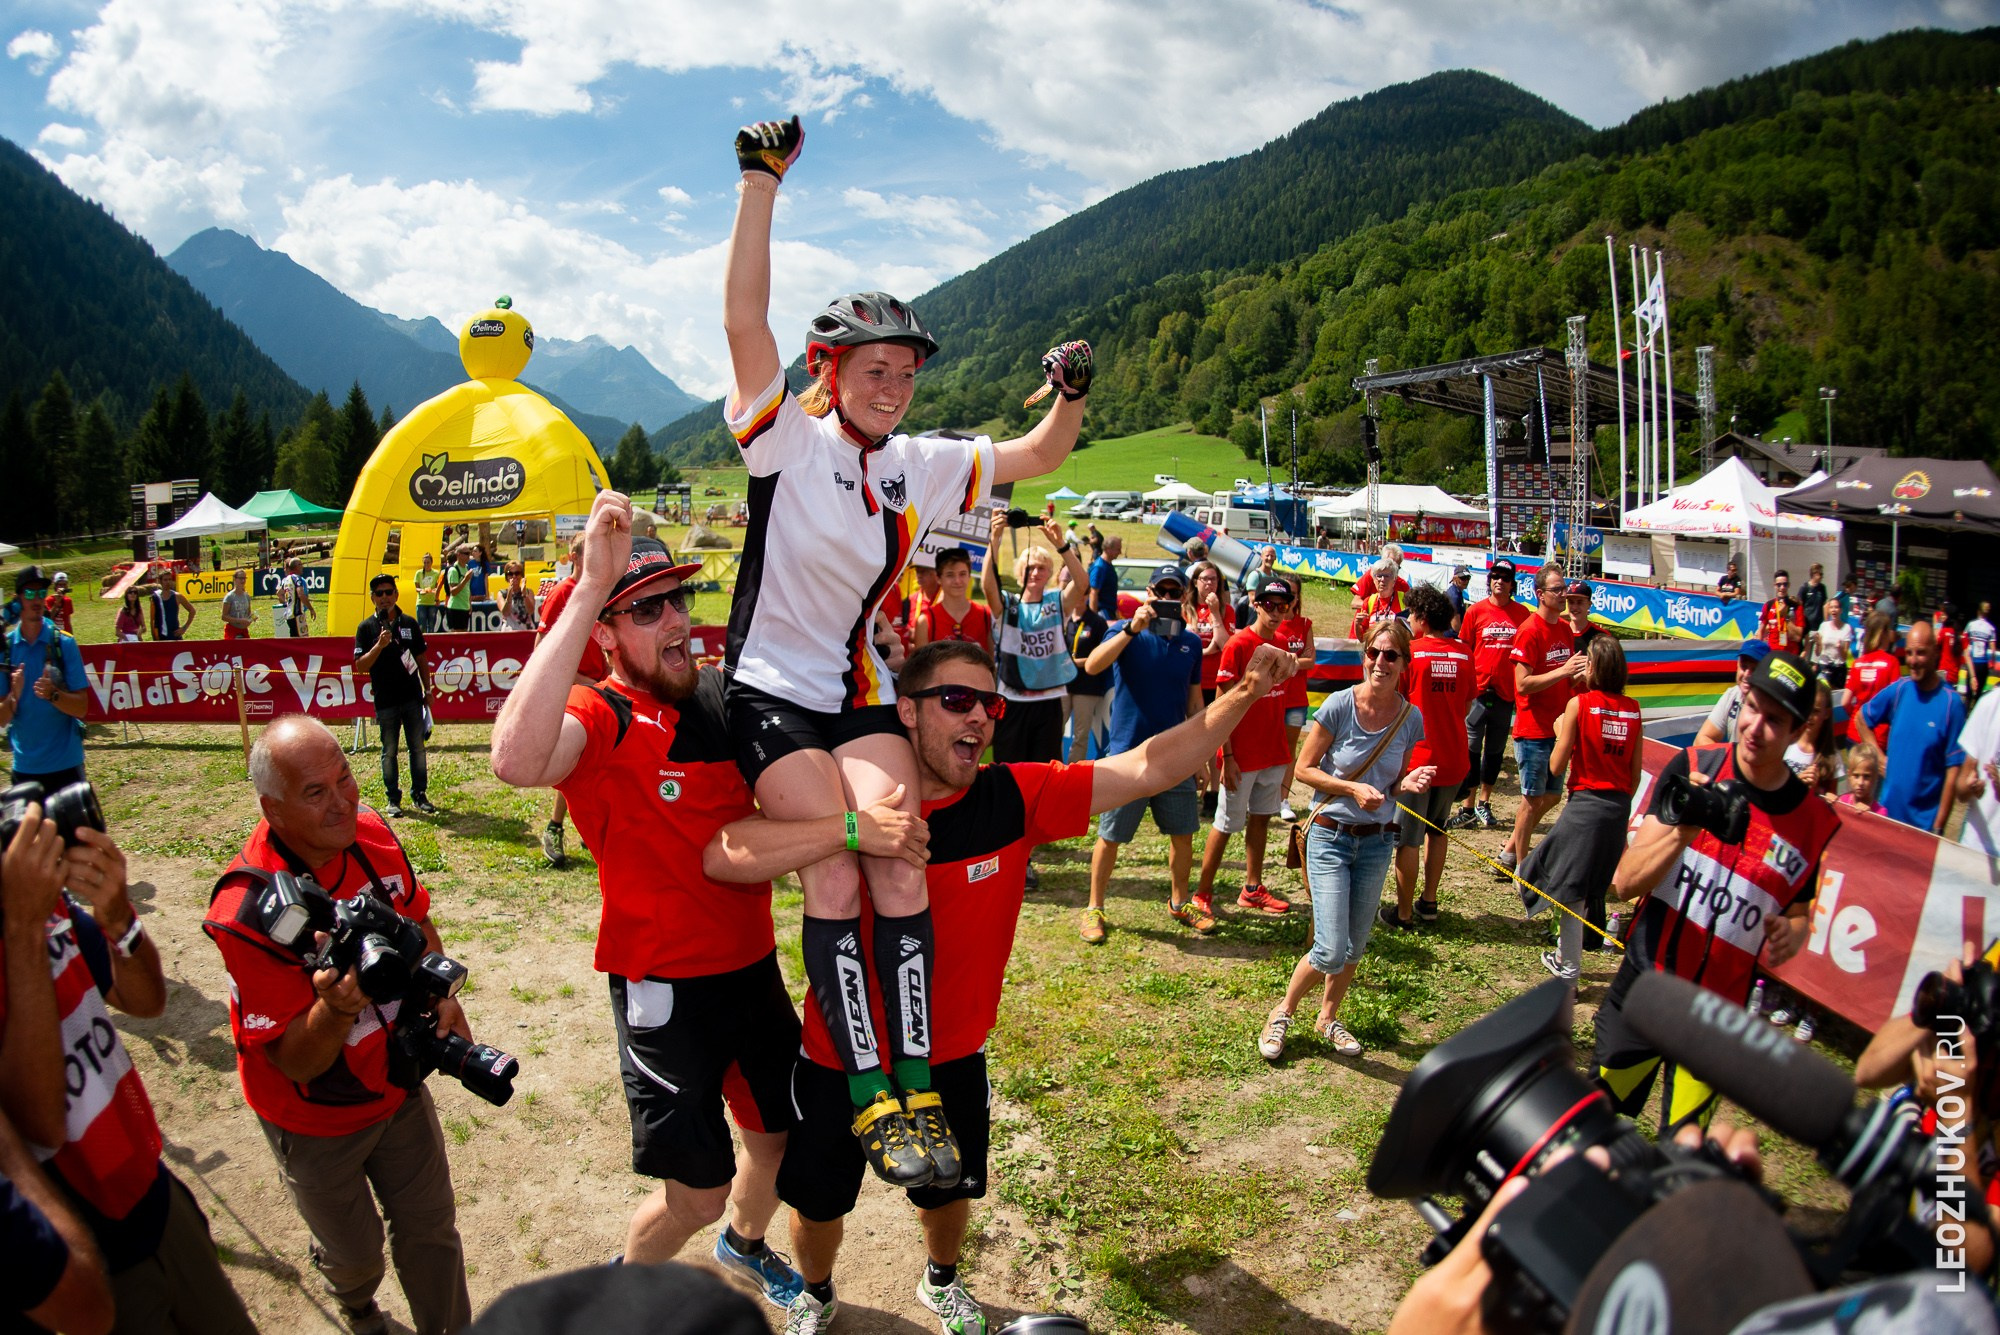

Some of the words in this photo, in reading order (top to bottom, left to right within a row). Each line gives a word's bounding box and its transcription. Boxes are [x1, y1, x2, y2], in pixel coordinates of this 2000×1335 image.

[471, 323, 504, 333] Melinda
[415, 467, 520, 496] Melinda
[444, 498, 465, 506] MELA
[466, 496, 480, 505] VAL
[490, 493, 511, 503] NON
[1672, 498, 1690, 510] Val
[1700, 499, 1736, 513] Sole
[1665, 598, 1723, 627] TRENTINO
[1020, 643, 1054, 657] RADIO
[85, 659, 144, 715] Val
[146, 675, 175, 706] di
[171, 651, 273, 704] Sole
[430, 649, 522, 698] ole
[1431, 664, 1457, 674] WORLD
[280, 655, 356, 713] Val
[1602, 724, 1628, 735] WORLD
[1776, 845, 1803, 877] UCI
[1674, 862, 1762, 932] PHOTO
[843, 967, 871, 1051] CLEAN
[907, 967, 926, 1048] CLEAN
